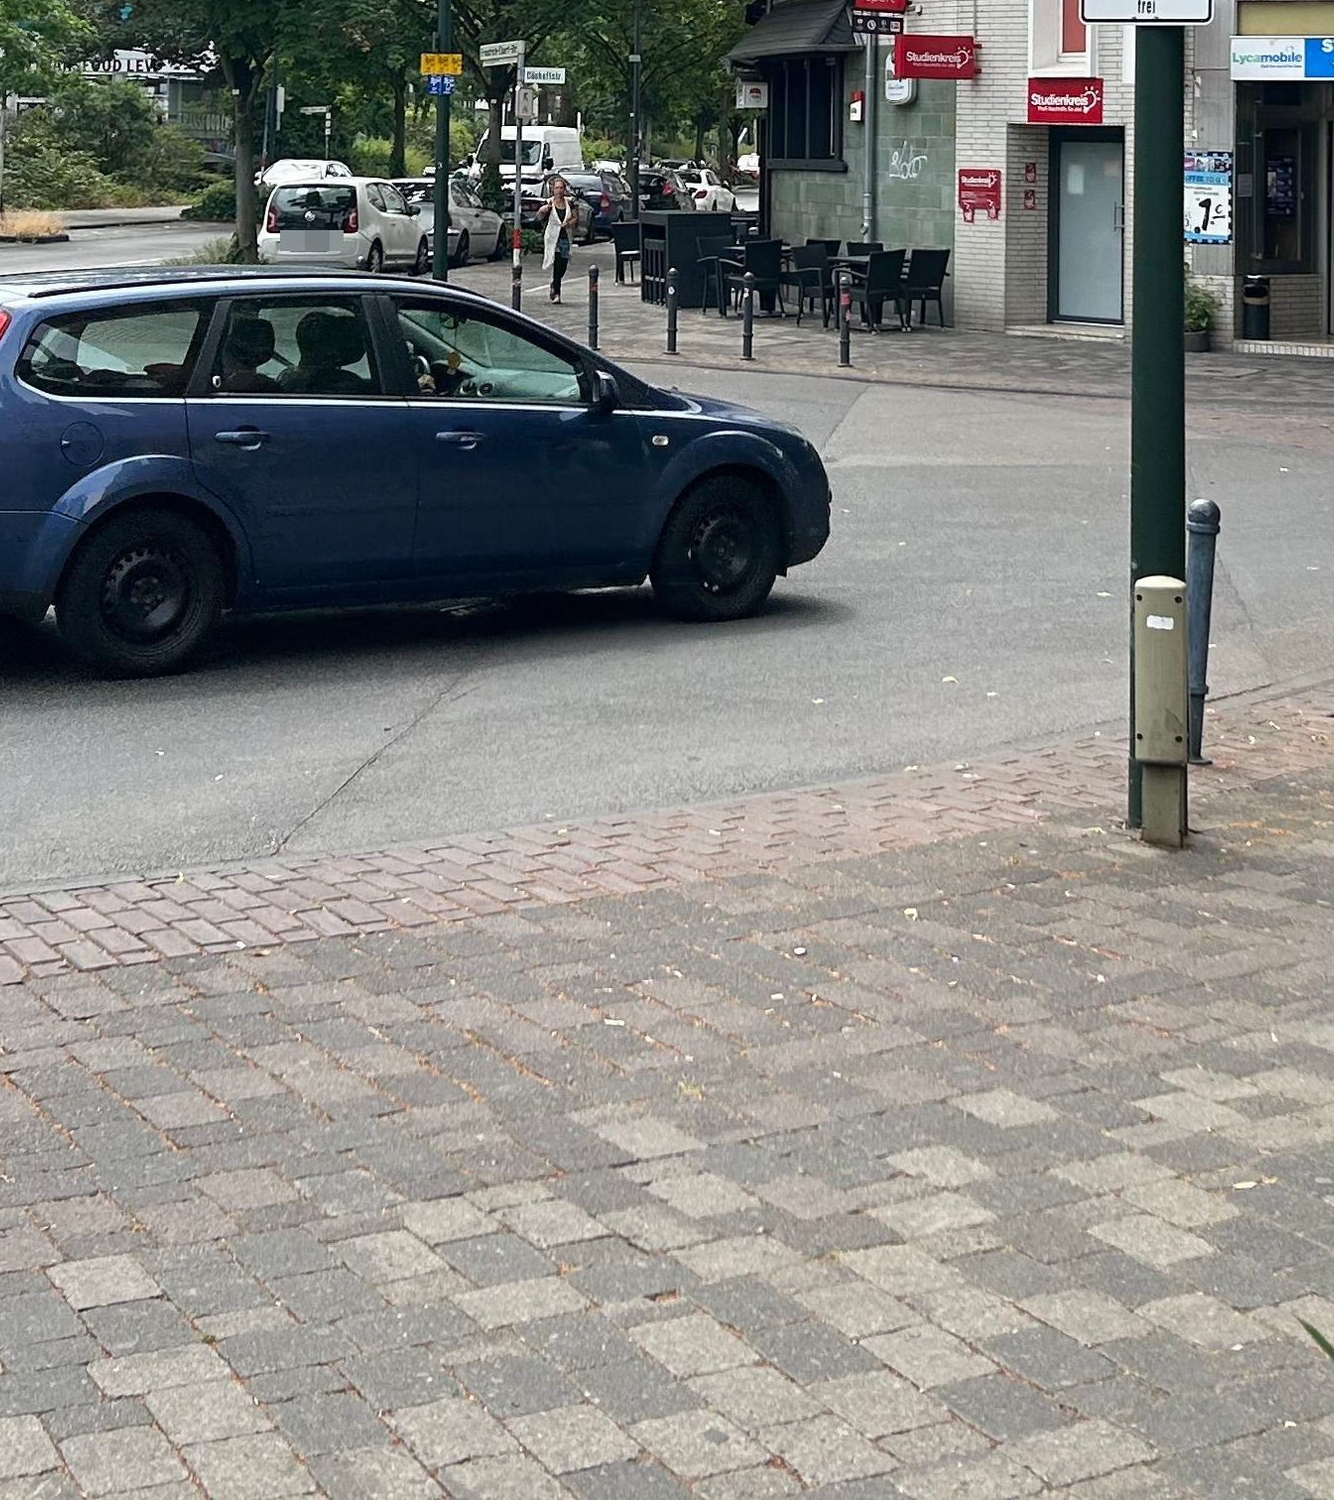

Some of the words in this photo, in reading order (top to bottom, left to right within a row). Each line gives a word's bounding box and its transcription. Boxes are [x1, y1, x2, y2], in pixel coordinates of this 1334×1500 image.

[906, 51, 962, 63] Studienkreis
[1232, 51, 1303, 65] Lycamobile
[1031, 93, 1089, 106] Studienkreis
